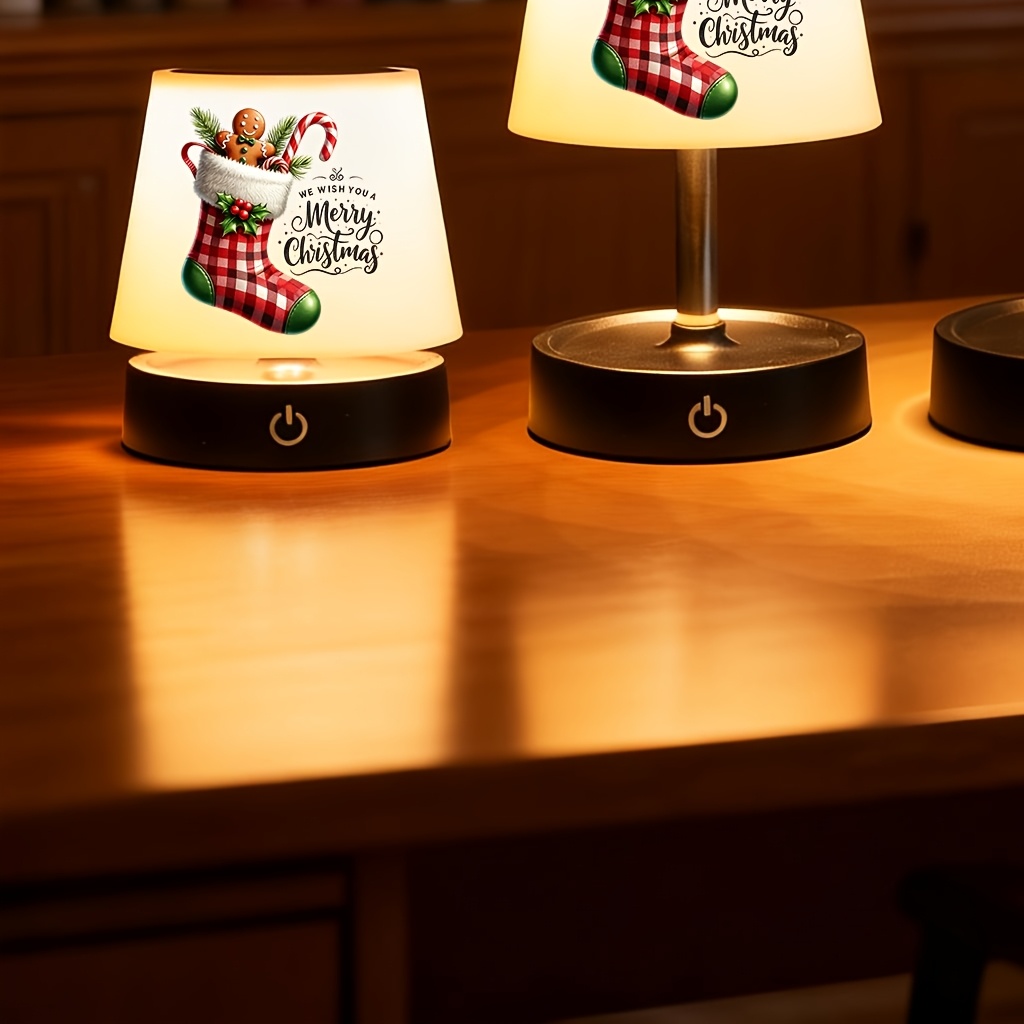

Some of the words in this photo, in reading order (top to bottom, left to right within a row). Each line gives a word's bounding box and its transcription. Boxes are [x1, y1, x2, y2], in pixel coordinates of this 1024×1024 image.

[698, 9, 799, 57] Christmas
[298, 188, 314, 199] WE
[317, 184, 345, 194] WISH
[348, 186, 369, 197] YOU
[370, 193, 376, 201] A
[291, 200, 377, 241] Merry
[283, 229, 379, 275] Christmas
